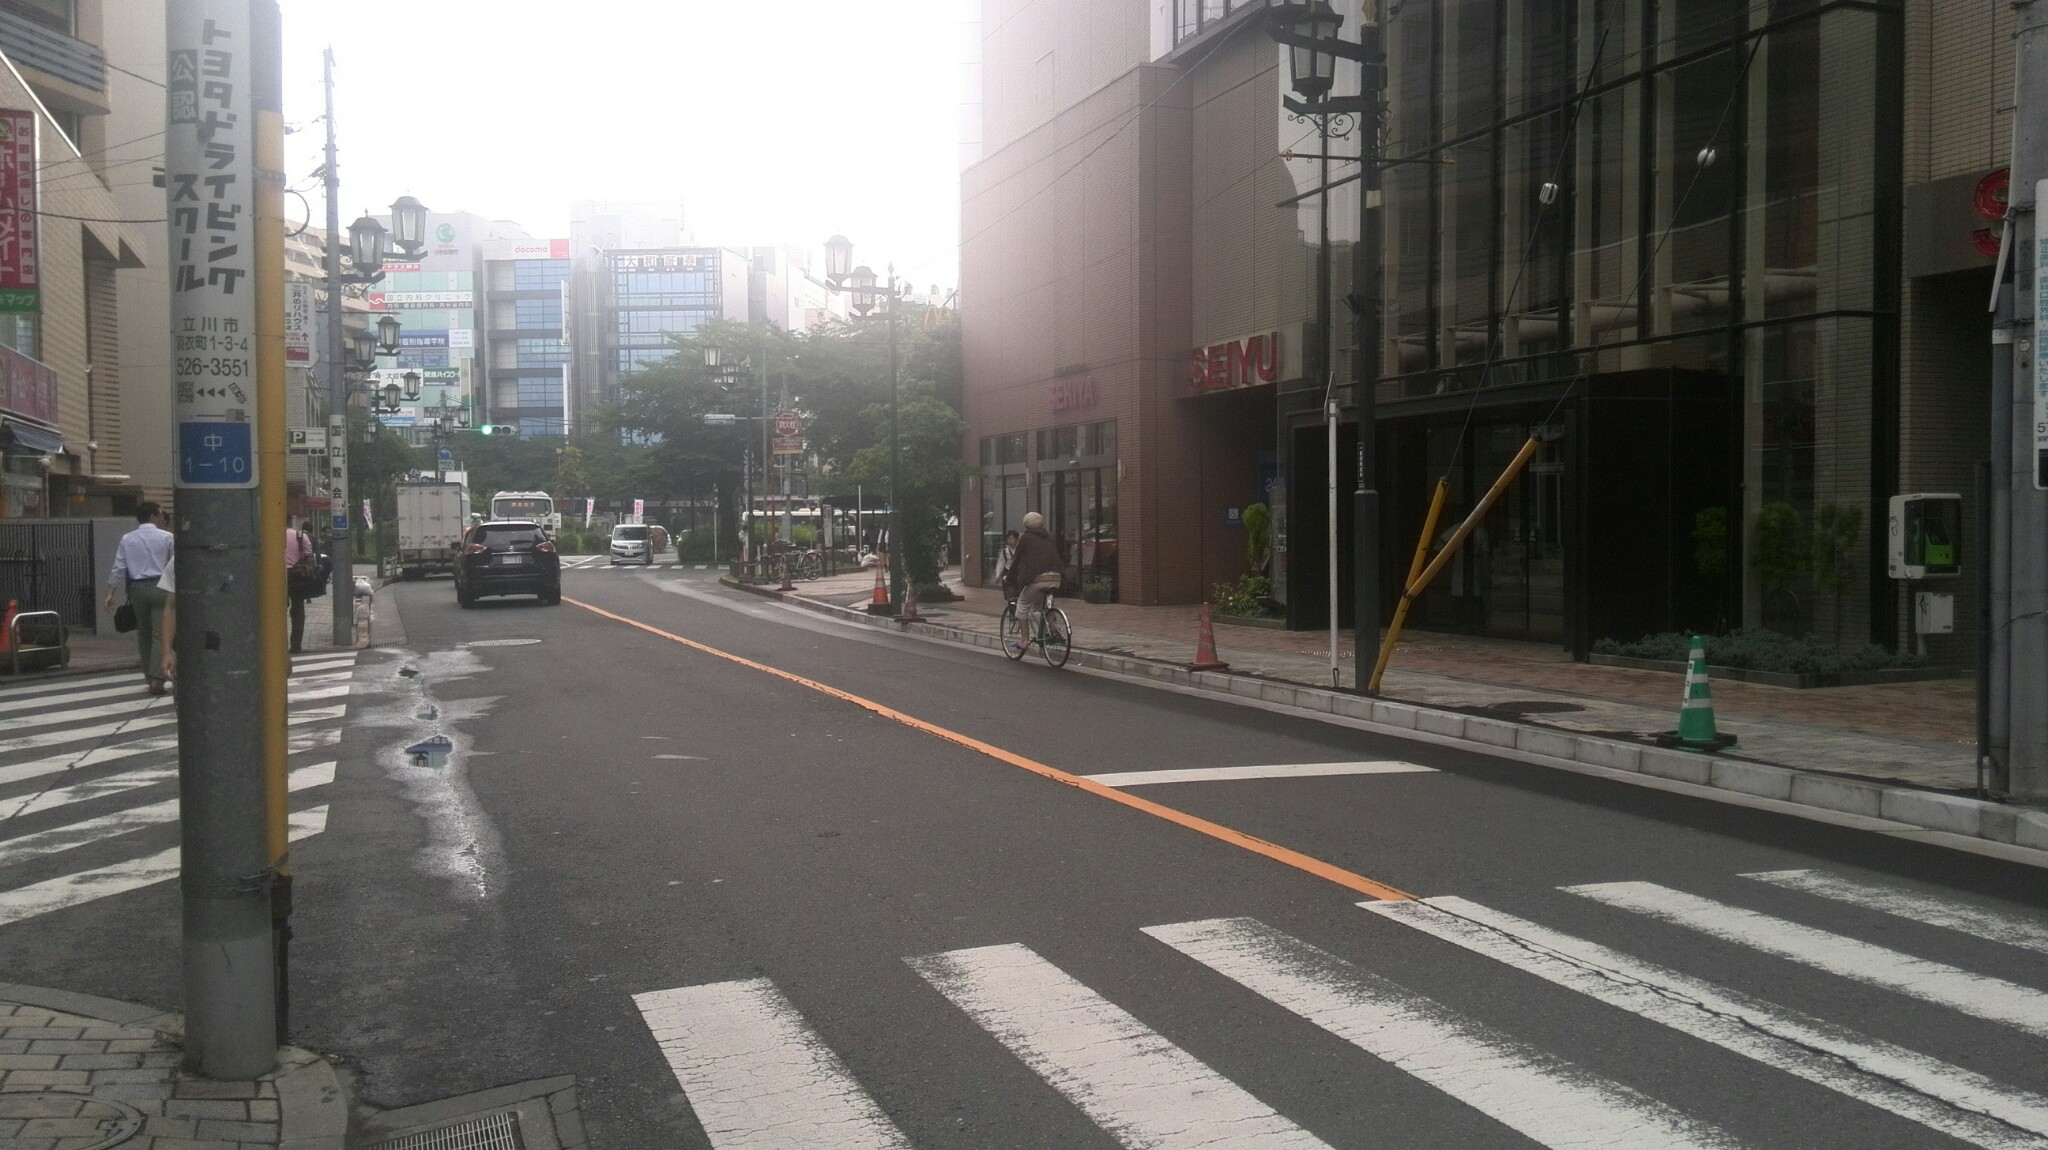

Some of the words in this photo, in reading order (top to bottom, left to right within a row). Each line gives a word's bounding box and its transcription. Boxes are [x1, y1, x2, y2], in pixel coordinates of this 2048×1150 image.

[201, 18, 246, 295] トヨタドライビング
[172, 172, 206, 293] スクール
[514, 245, 548, 254] docomo
[626, 255, 697, 267] 大和証券
[386, 293, 471, 301] 国立内科クリニック
[182, 316, 239, 333] 立川市
[398, 337, 446, 346] 個別指導学院
[176, 356, 250, 378] 526-3551
[1190, 332, 1277, 392] SEIYU
[204, 433, 223, 451] 中
[292, 431, 303, 443] P
